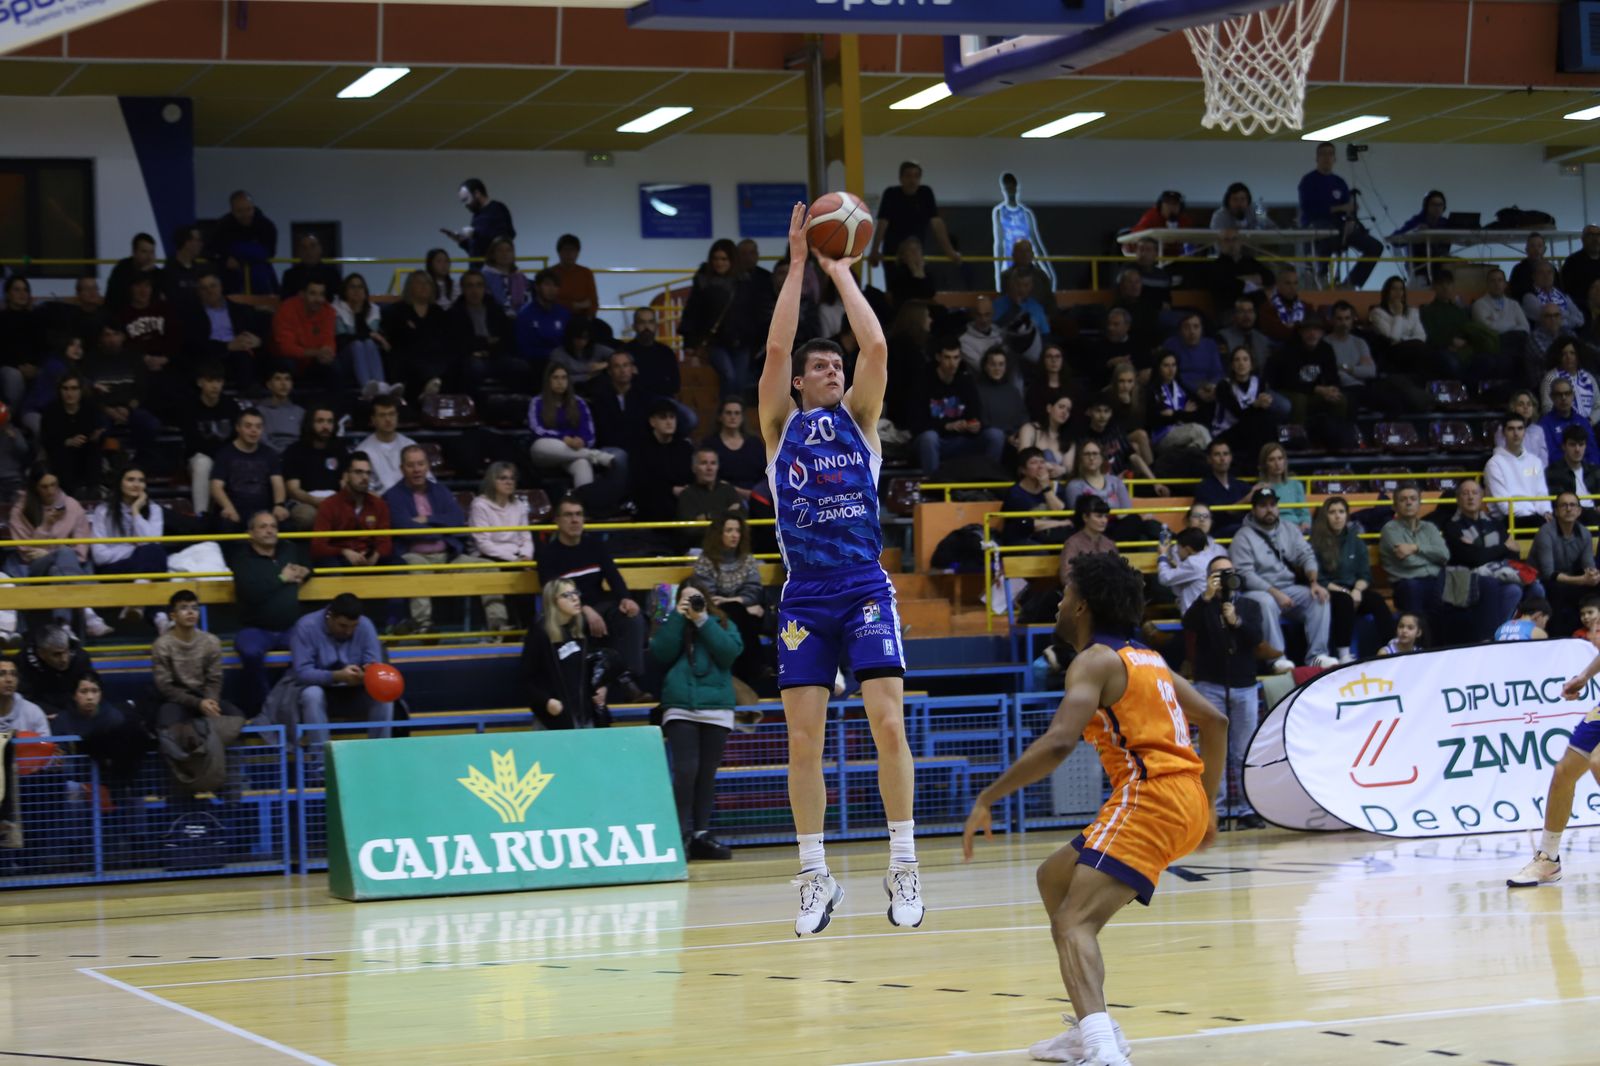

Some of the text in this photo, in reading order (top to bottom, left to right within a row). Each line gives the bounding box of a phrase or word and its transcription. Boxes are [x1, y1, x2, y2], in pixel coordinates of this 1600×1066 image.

[804, 416, 835, 445] 20
[813, 452, 864, 472] INNOVA
[816, 505, 866, 522] ZAMORA
[358, 824, 677, 880] CAJA RURAL
